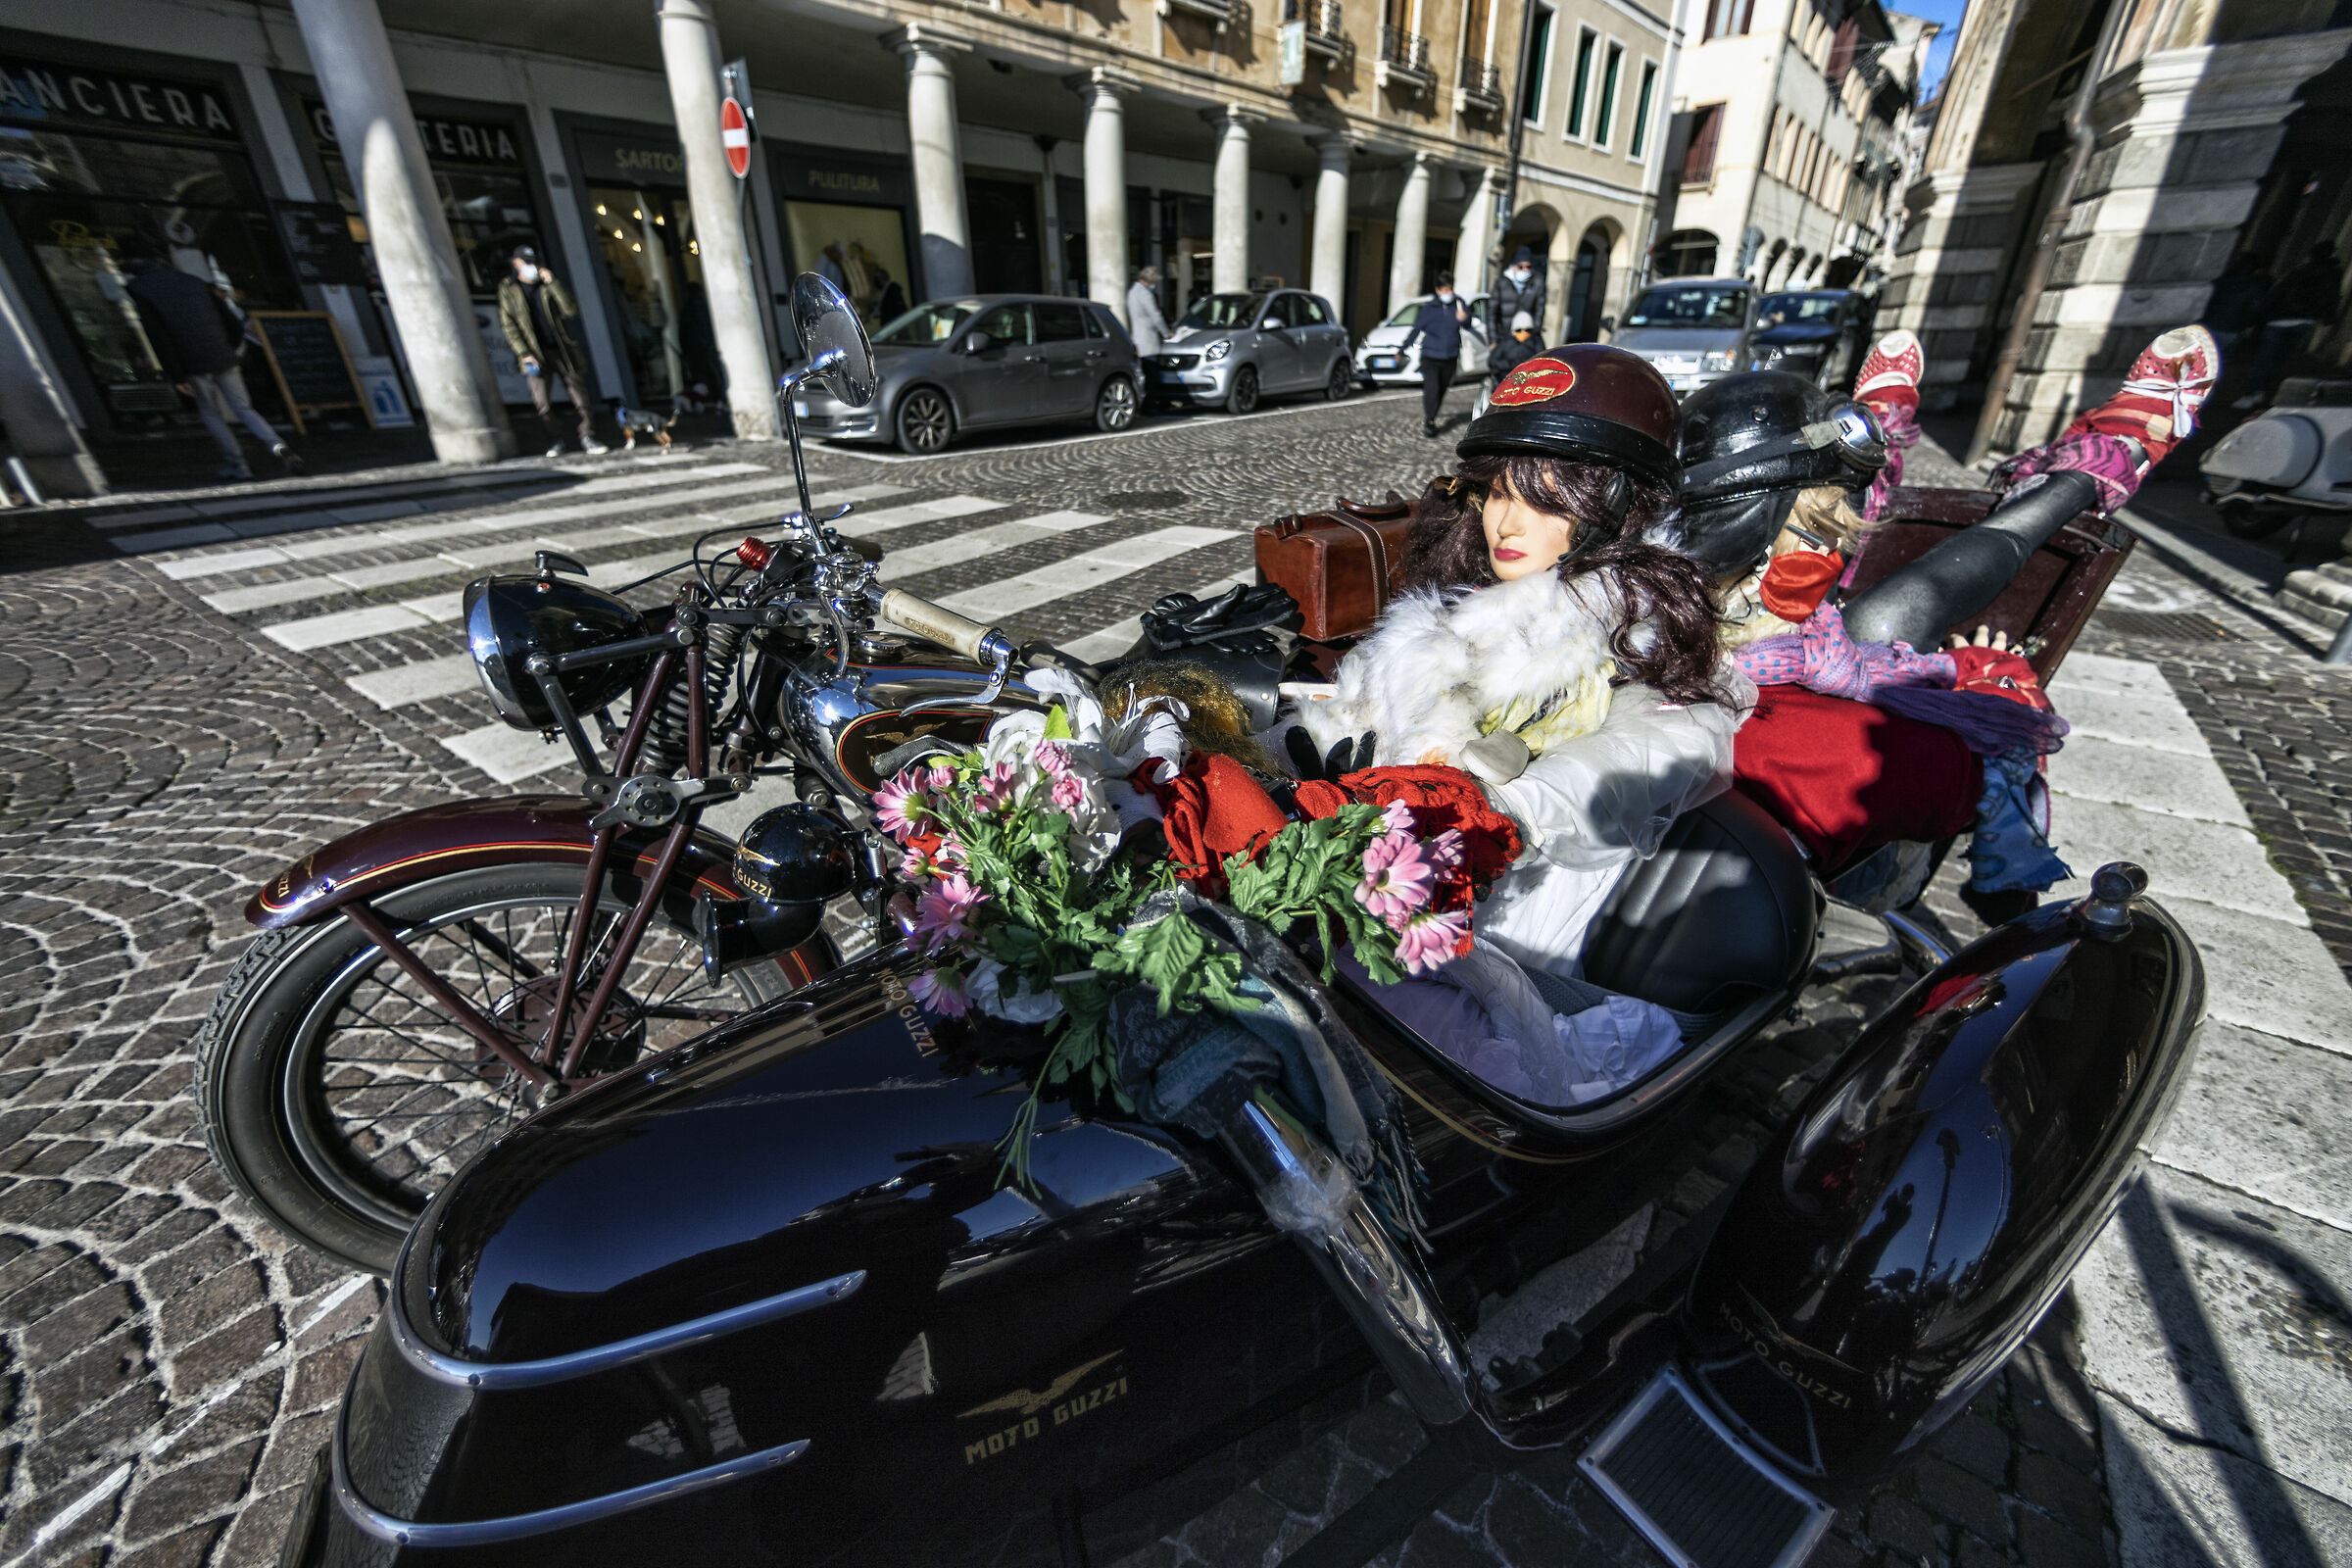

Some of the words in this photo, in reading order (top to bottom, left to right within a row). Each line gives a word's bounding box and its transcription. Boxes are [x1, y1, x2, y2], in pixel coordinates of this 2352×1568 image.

[1524, 386, 1555, 396] GUZZI
[737, 868, 771, 898] GUZZI
[879, 967, 907, 1001] MOTO
[899, 1004, 940, 1057] GUZZI
[1719, 1301, 1770, 1357] MOTO
[1778, 1360, 1851, 1409] GUZZI
[964, 1417, 1040, 1465] MOTO
[1053, 1376, 1128, 1426] GUZZI
